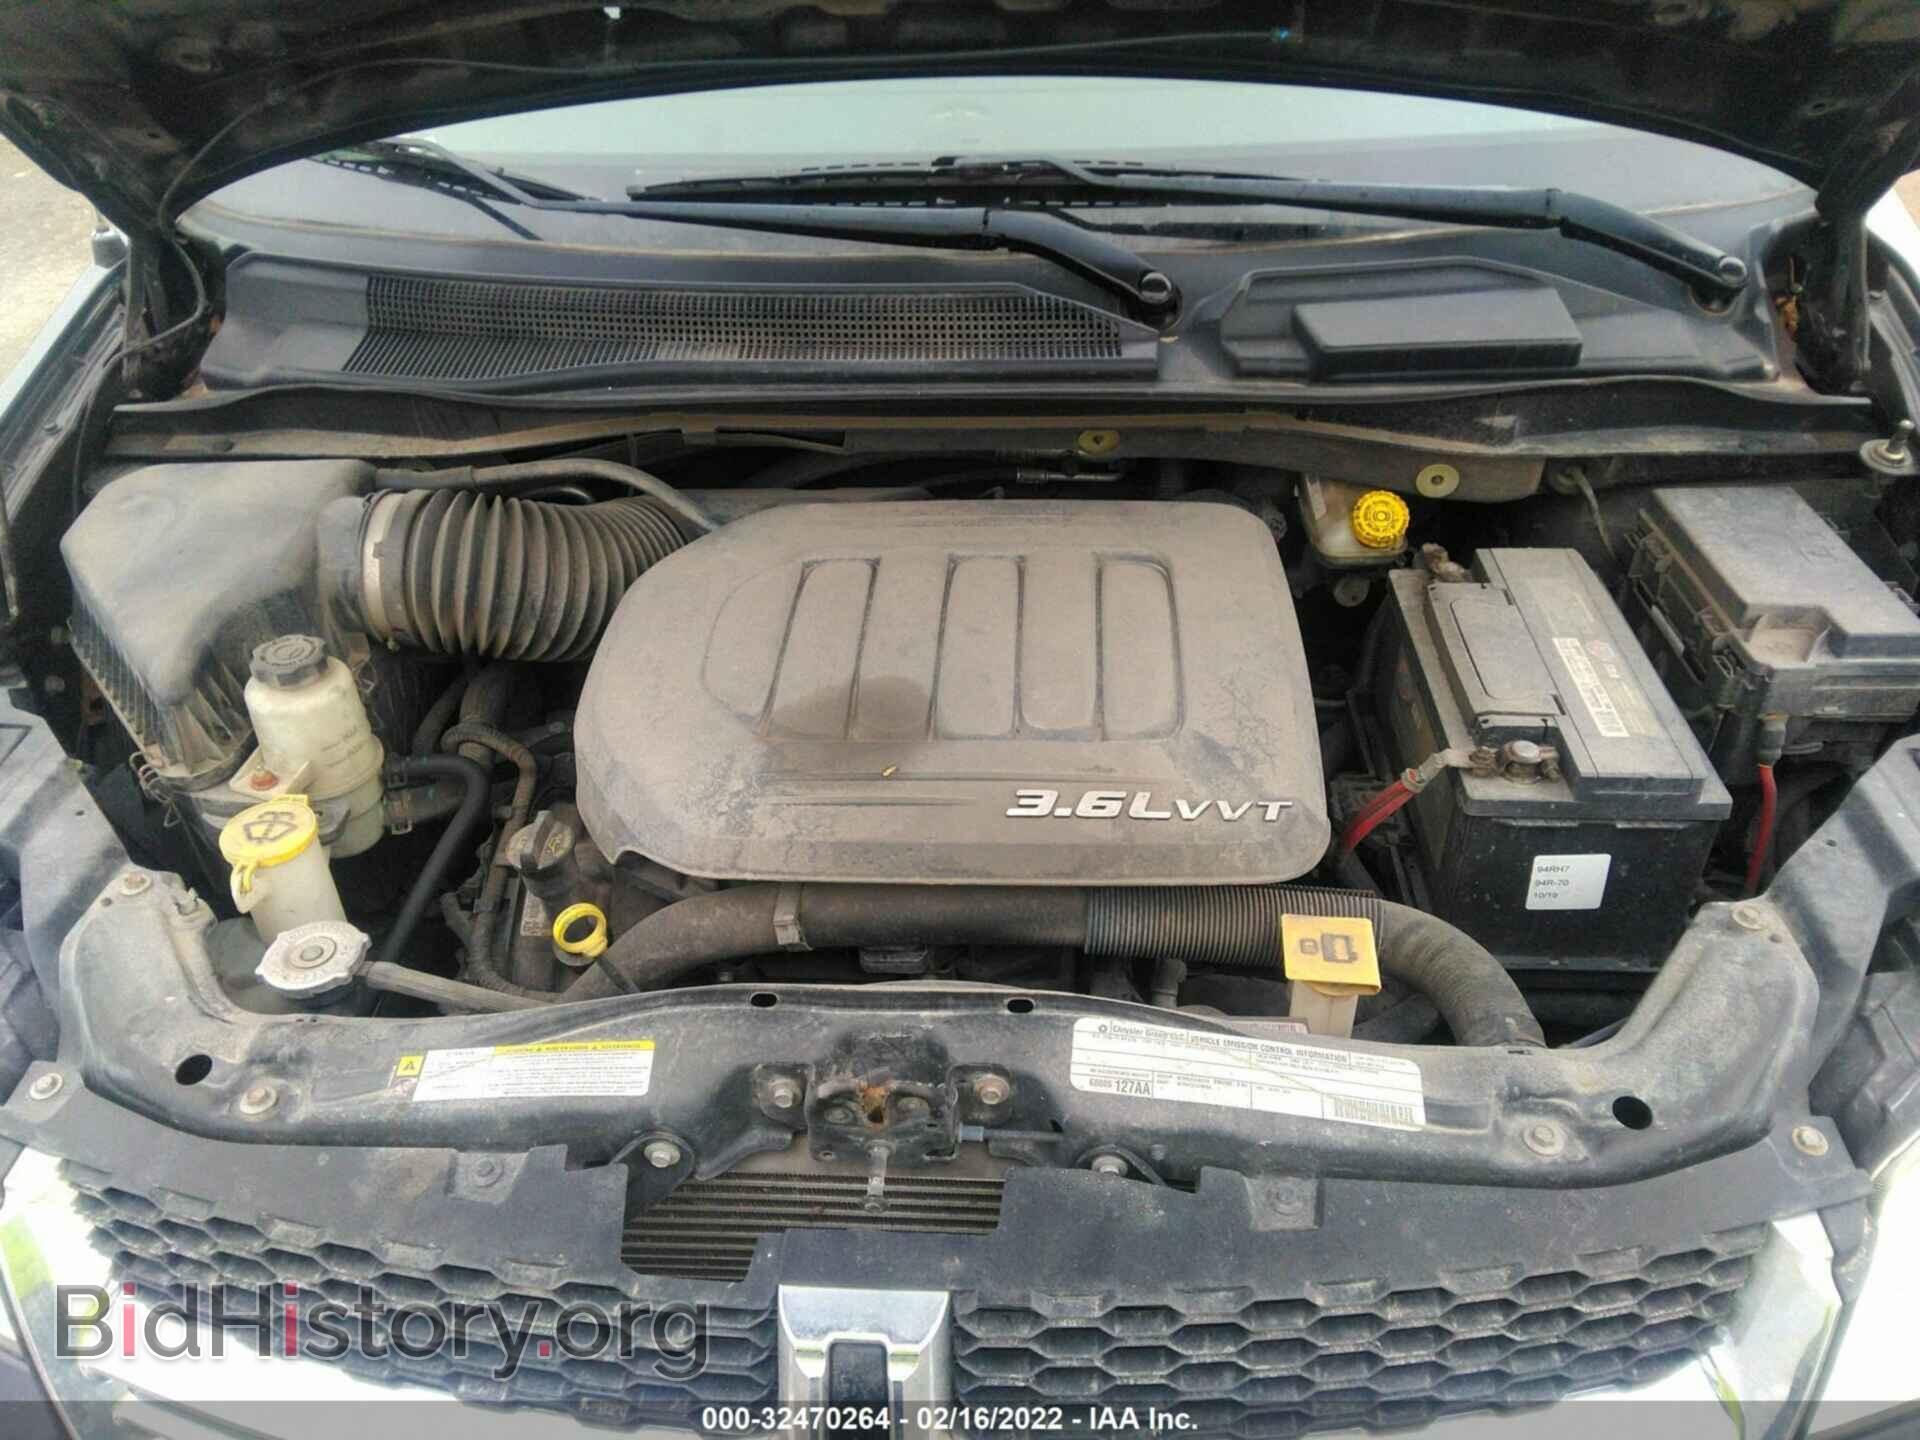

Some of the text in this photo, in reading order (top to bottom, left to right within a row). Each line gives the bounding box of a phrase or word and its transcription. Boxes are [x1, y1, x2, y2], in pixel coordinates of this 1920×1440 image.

[1223, 1038, 1259, 1051] EMISSION
[1260, 1043, 1293, 1056] CONTROL
[1296, 1048, 1348, 1063] INFORMATION
[1115, 1079, 1151, 1096] 127AA
